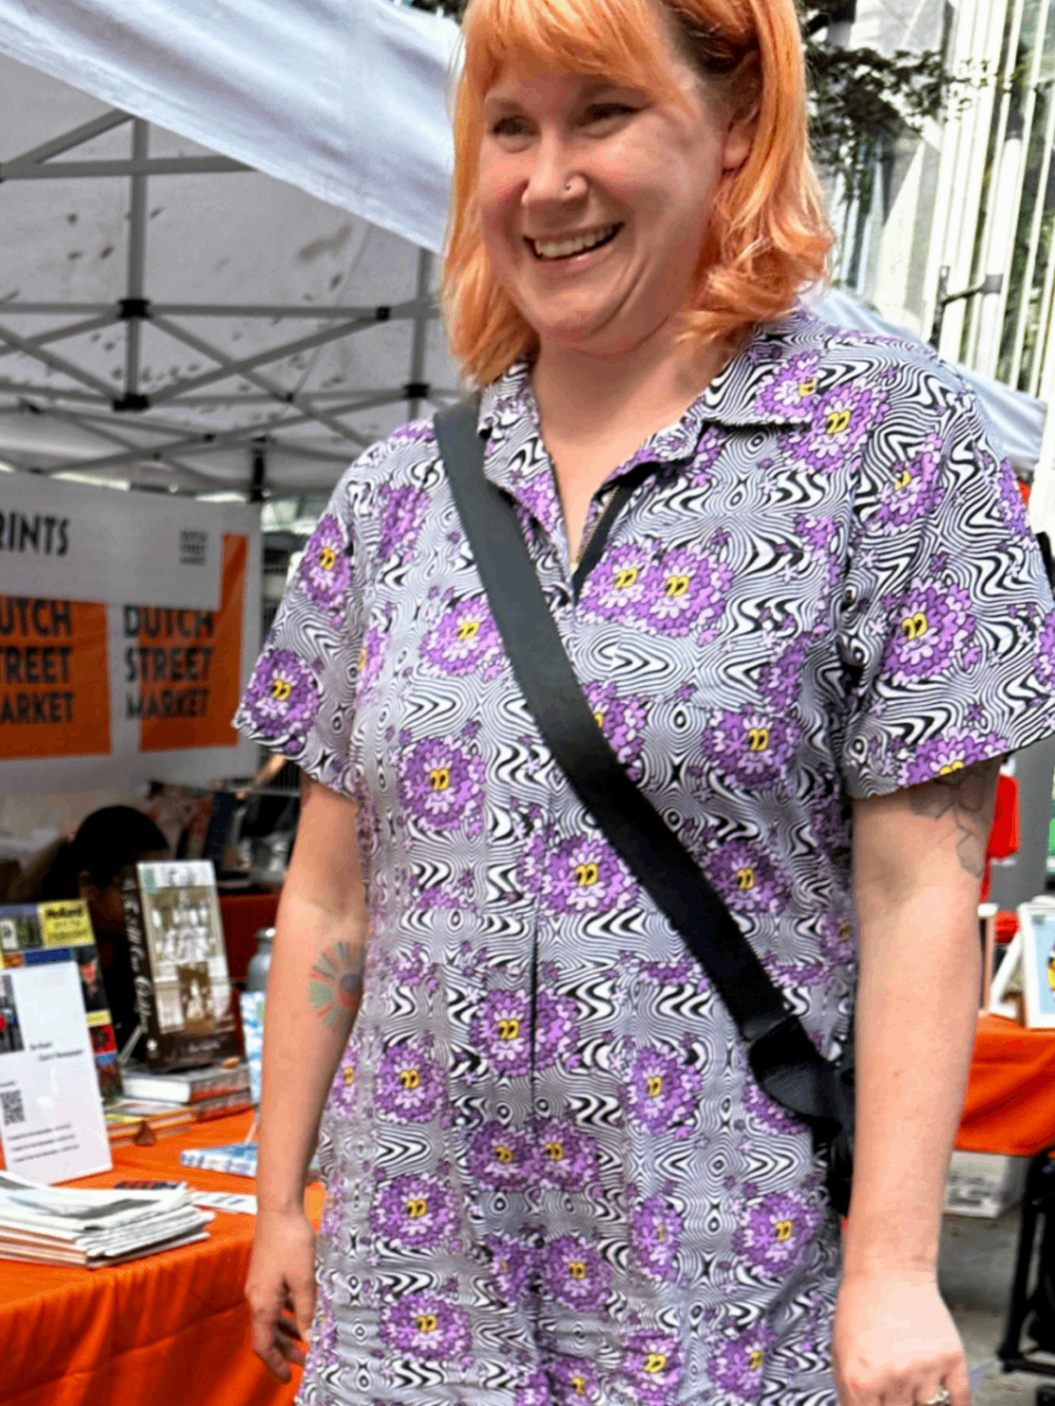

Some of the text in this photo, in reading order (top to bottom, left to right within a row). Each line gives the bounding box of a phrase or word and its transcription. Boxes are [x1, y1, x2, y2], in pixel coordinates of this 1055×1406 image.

[123, 604, 214, 639] DUTCH
[124, 647, 214, 683] STREET
[125, 687, 209, 721] MARKET
